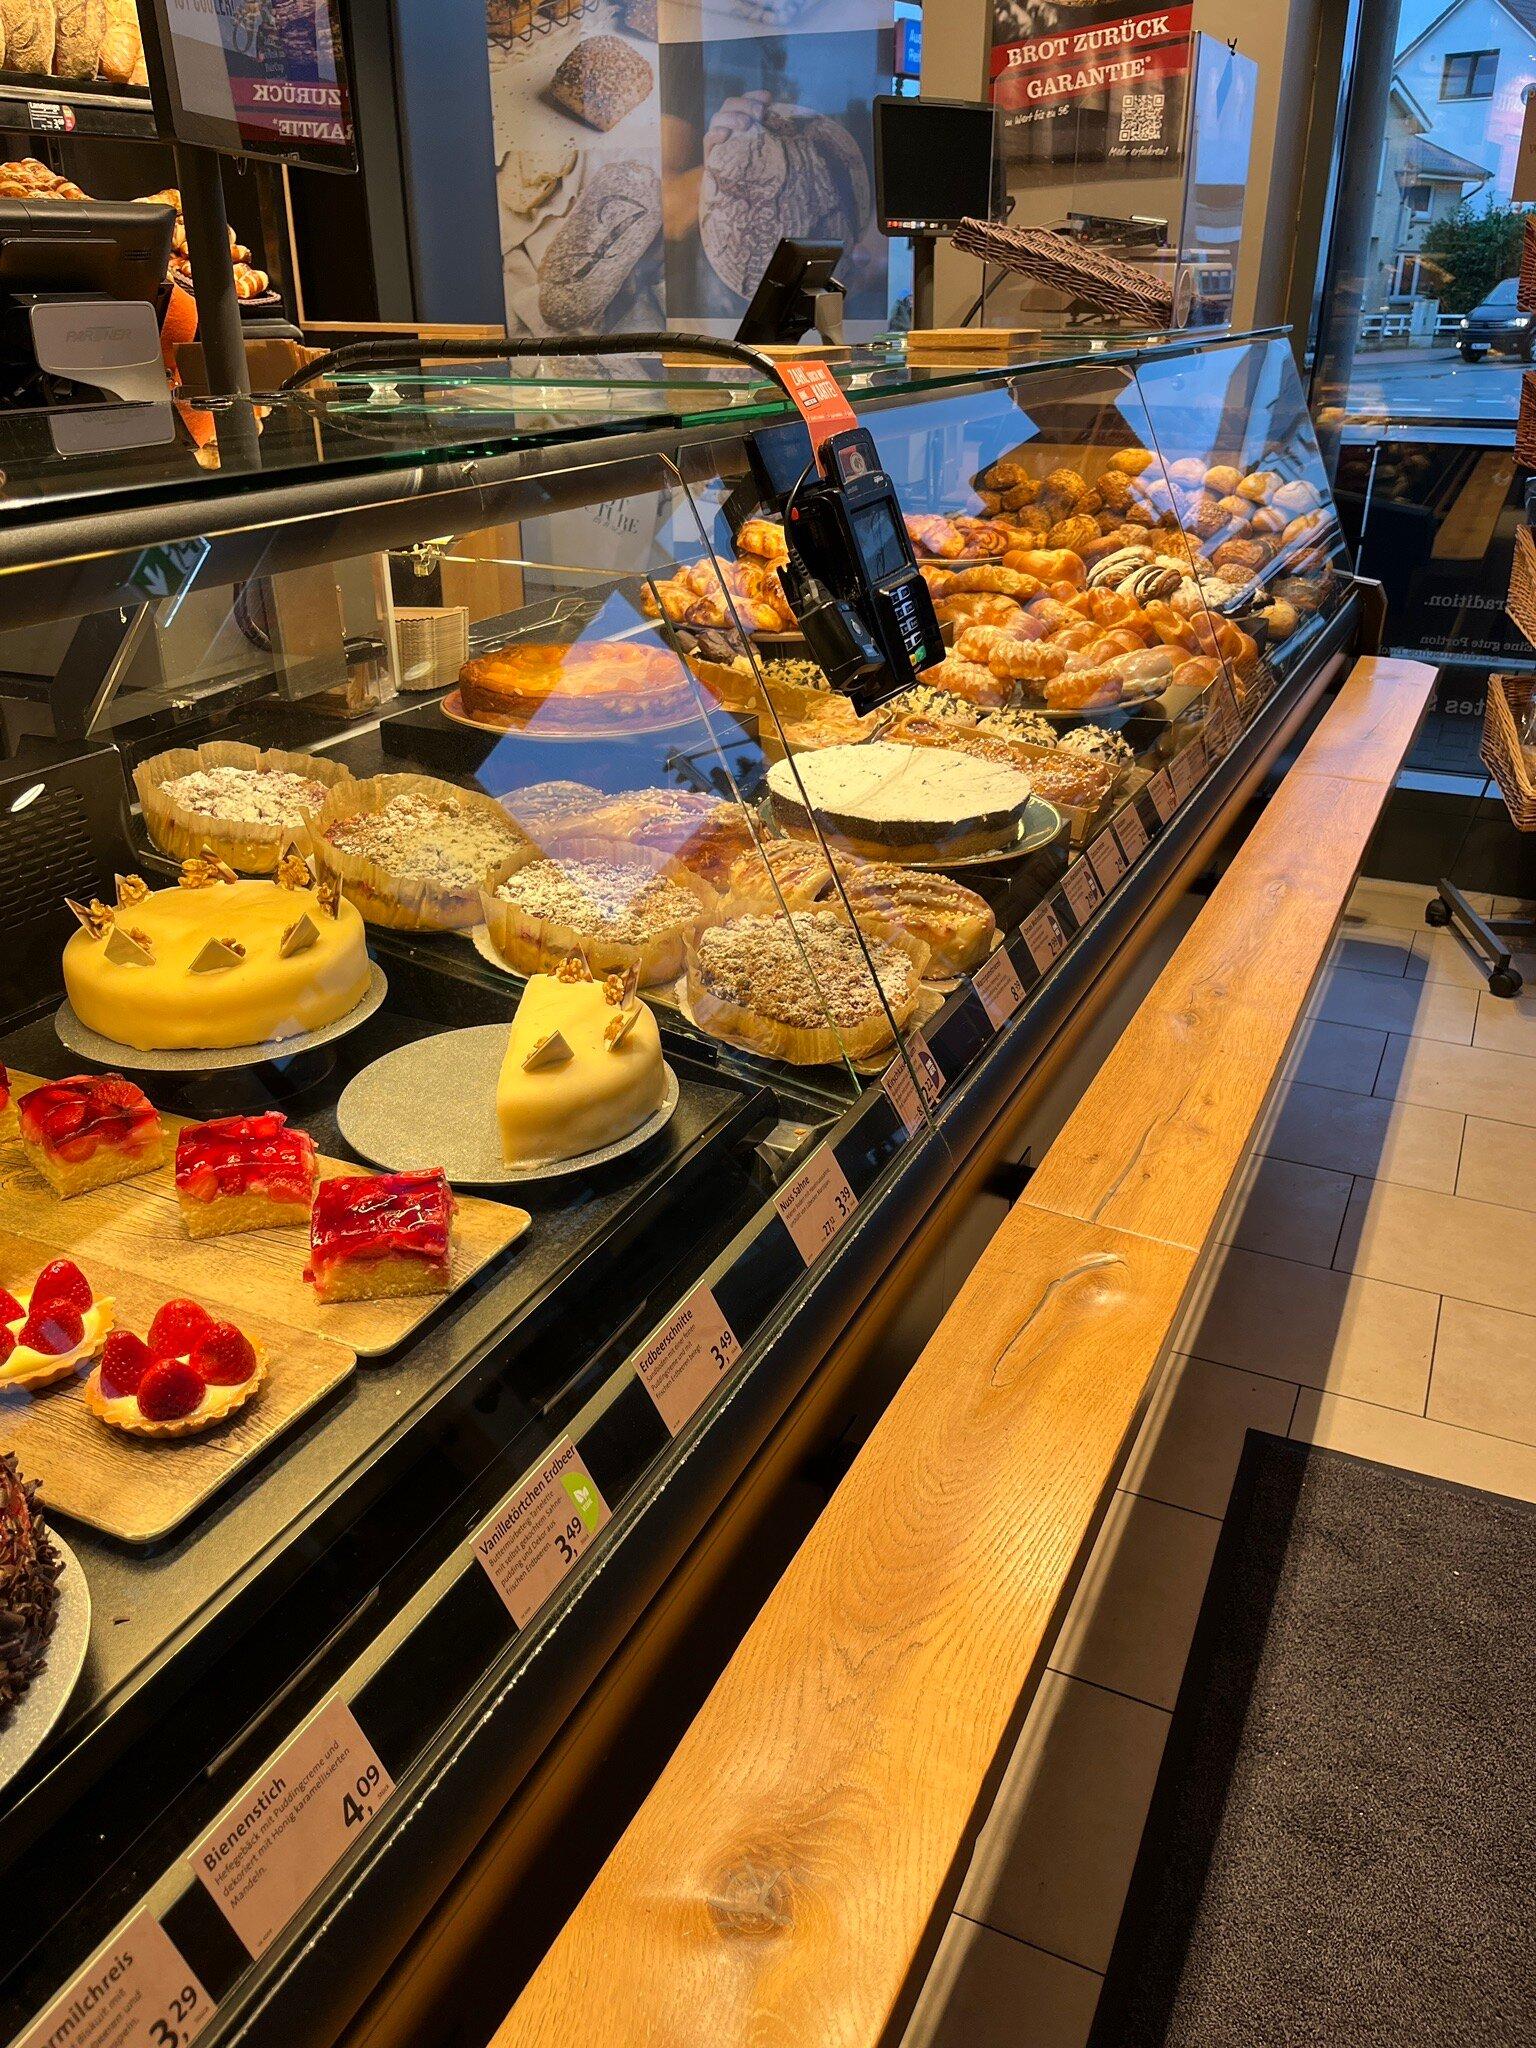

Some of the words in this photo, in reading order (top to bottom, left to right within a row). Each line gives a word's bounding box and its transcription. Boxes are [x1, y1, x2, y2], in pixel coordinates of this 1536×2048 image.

[1006, 37, 1069, 68] BROT
[1073, 15, 1170, 53] ZURÜCK
[779, 1193, 794, 1212] Nuss
[792, 1175, 810, 1198] Sahne
[834, 1186, 851, 1217] 3,39
[640, 1311, 693, 1373] Erdbeerschnitte
[667, 1347, 675, 1358] mit
[676, 1349, 685, 1360] und
[684, 1340, 692, 1351] mit
[709, 1330, 732, 1371] 3,49
[480, 1482, 545, 1557] Vanilletörtchen
[543, 1445, 576, 1485] Erdbeer
[494, 1562, 505, 1576] mit
[504, 1545, 520, 1565] selbst
[519, 1515, 547, 1549] gekochtem
[500, 1560, 523, 1588] pudding
[521, 1546, 533, 1561] und
[531, 1530, 547, 1549] Dekor
[546, 1520, 556, 1532] aus
[554, 1516, 582, 1564] 3,49
[506, 1570, 527, 1596] frischen
[204, 1779, 287, 1872] Bienenstich
[214, 1832, 261, 1887] Hefegebäck
[259, 1815, 275, 1834] mit
[274, 1760, 326, 1820] Puddingcreme
[323, 1740, 340, 1760] und
[222, 1855, 259, 1897] dekoriert
[257, 1838, 273, 1856] mit
[271, 1811, 296, 1842] Honig
[294, 1750, 350, 1814] karamellisierten
[342, 1764, 380, 1828] 4,09
[230, 1865, 267, 1909] Mandeln.
[41, 1951, 134, 2048] rmilchreis
[149, 1985, 197, 2048] 3,29
